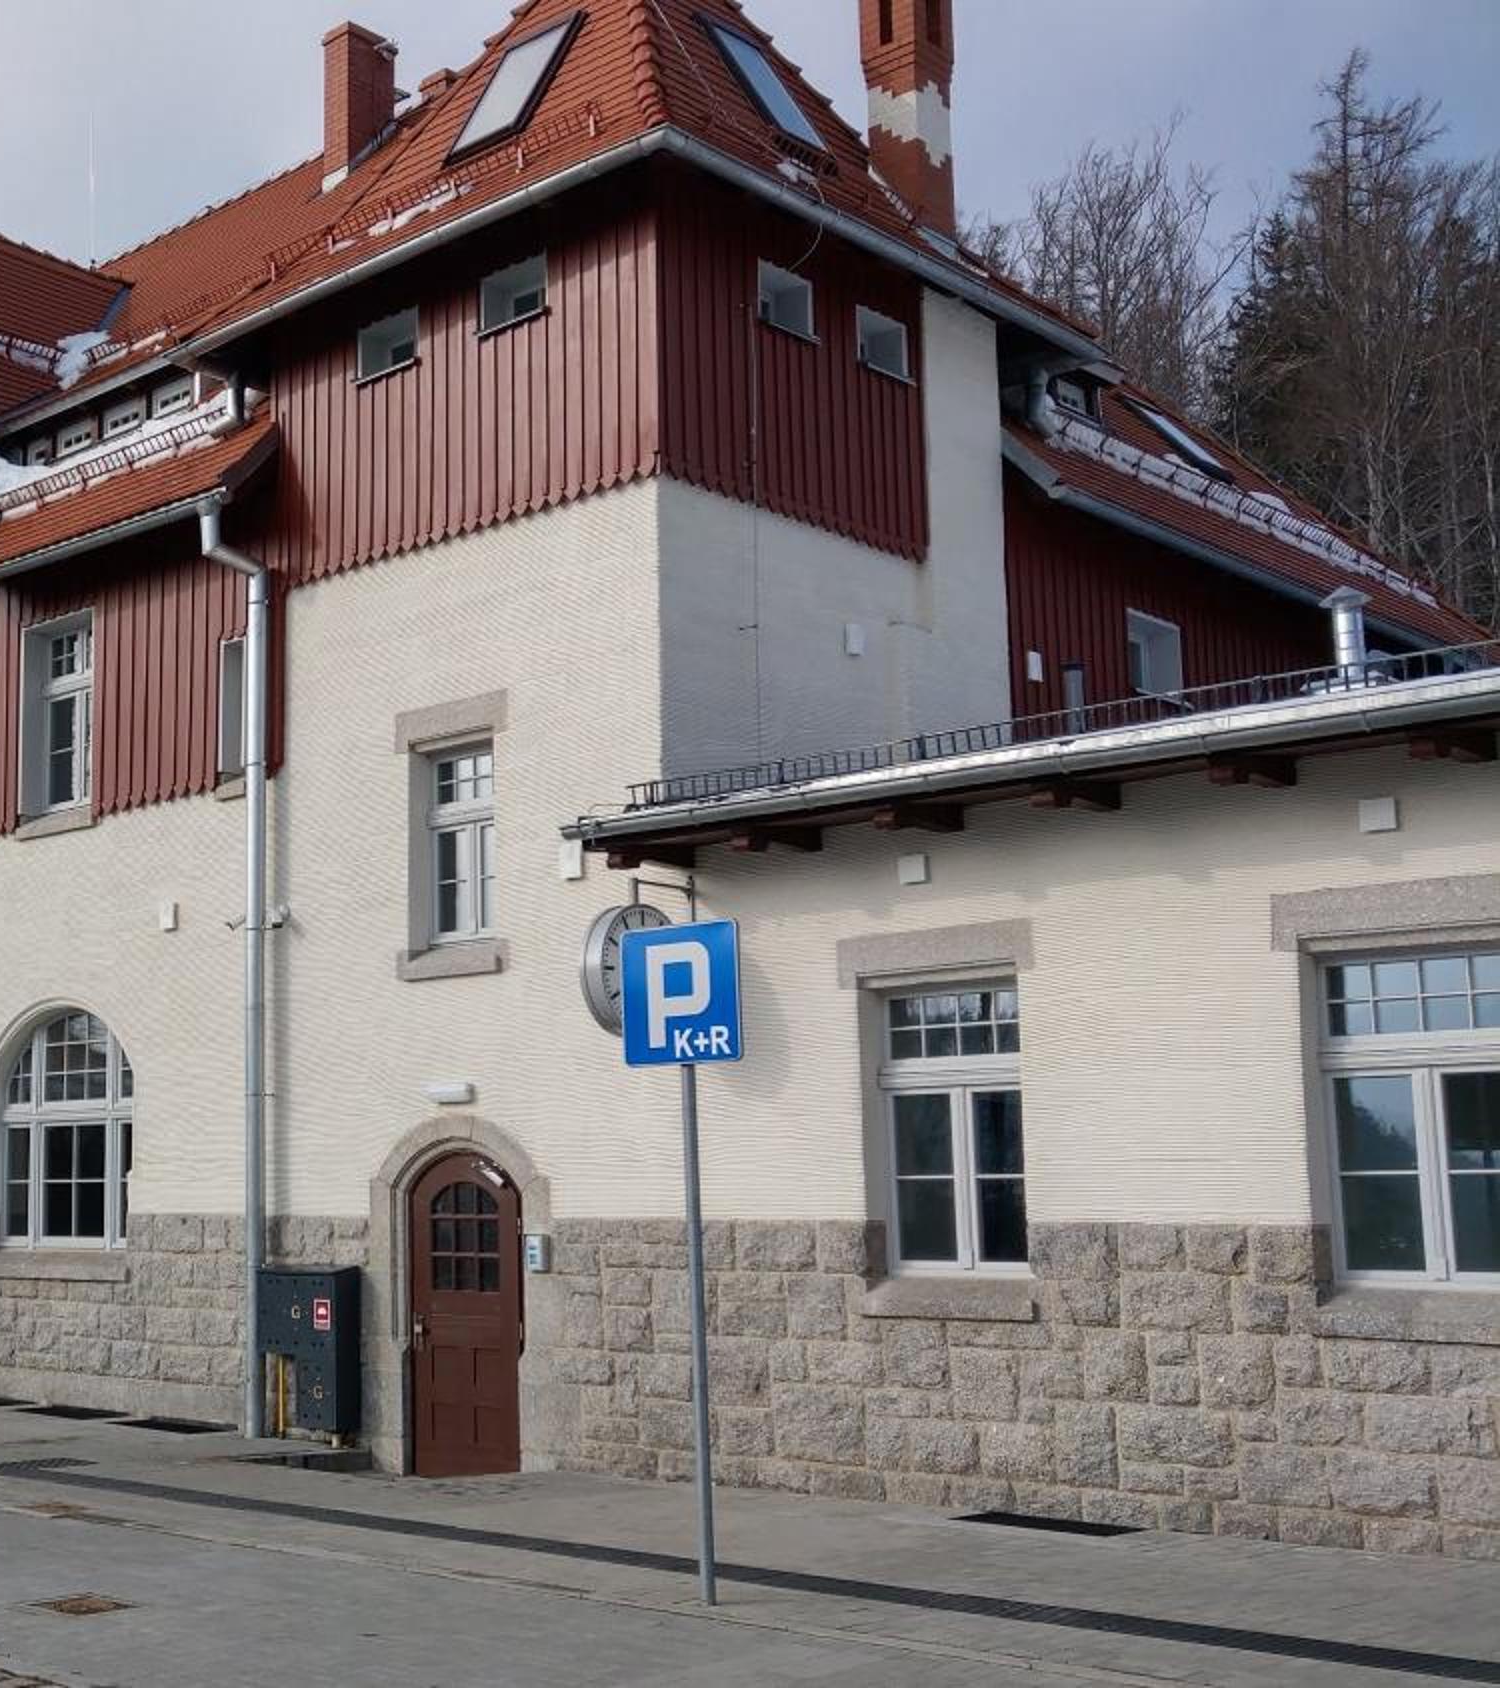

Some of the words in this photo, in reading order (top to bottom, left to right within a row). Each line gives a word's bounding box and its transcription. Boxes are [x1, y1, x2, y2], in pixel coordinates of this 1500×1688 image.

[645, 941, 710, 1048] P
[673, 1025, 732, 1058] K+R
[291, 1305, 301, 1319] G
[313, 1385, 323, 1399] G
